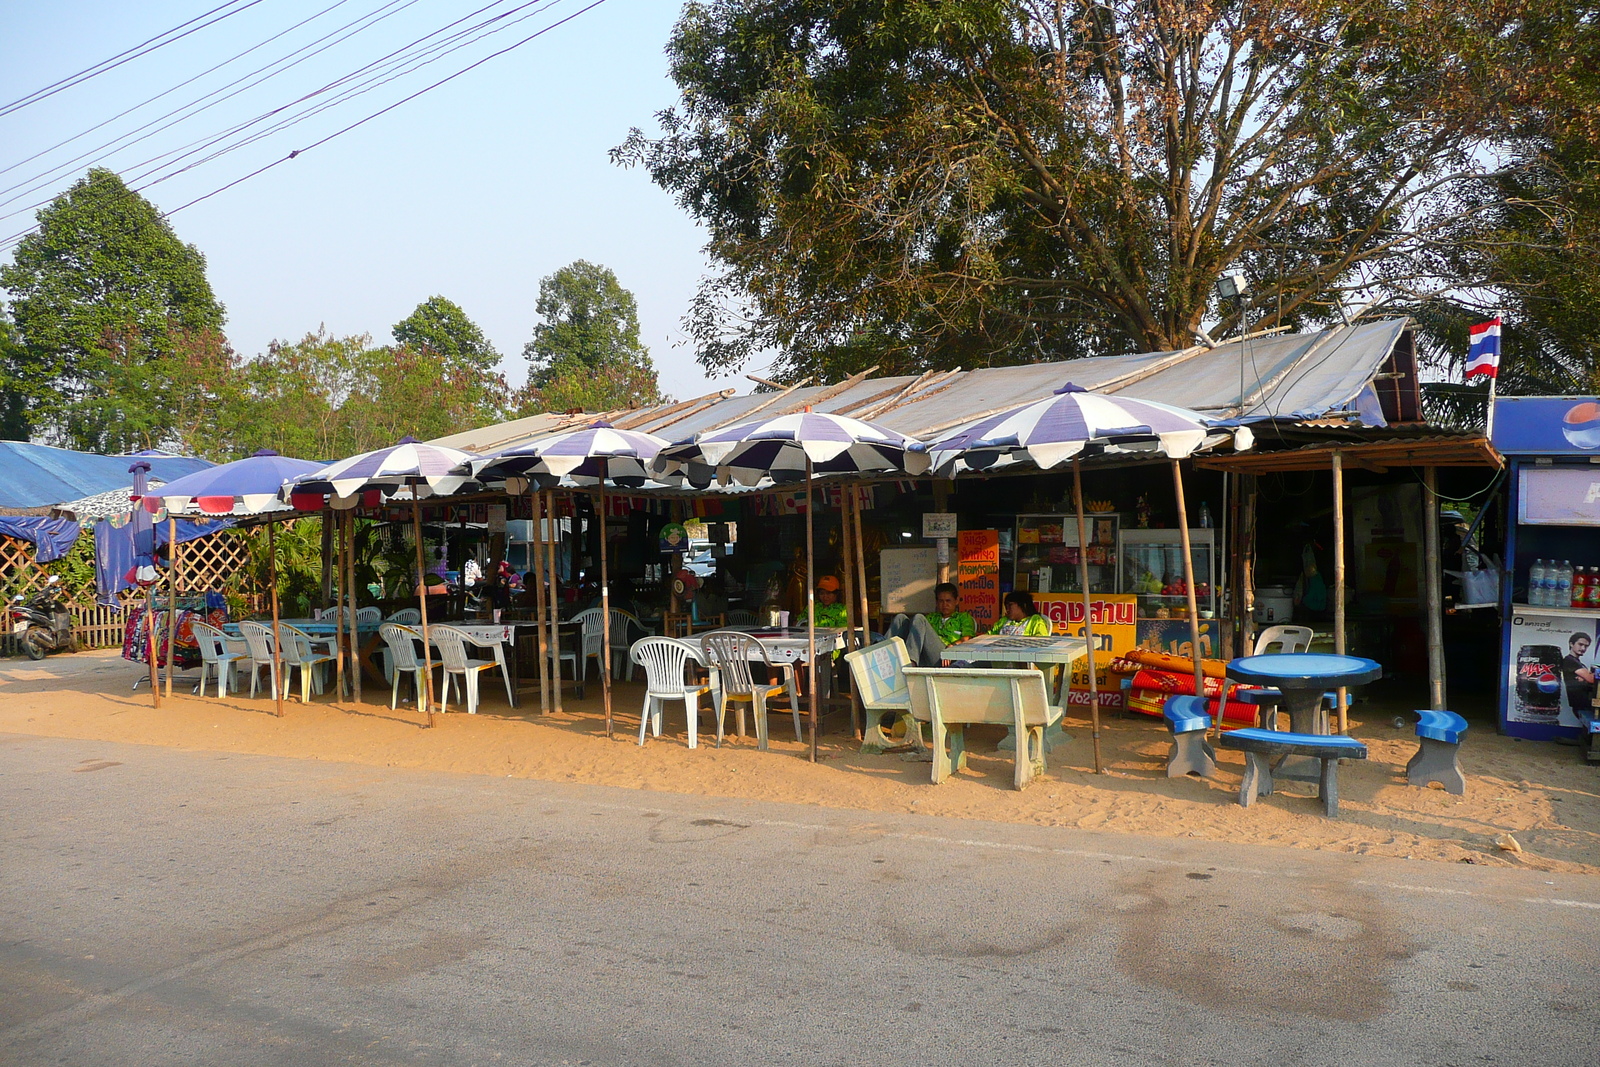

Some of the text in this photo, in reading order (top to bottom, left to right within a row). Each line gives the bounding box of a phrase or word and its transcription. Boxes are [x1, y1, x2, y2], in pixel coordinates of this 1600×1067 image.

[1519, 663, 1556, 677] MAX
[1081, 674, 1107, 686] Bat
[1068, 691, 1121, 706] 762172
